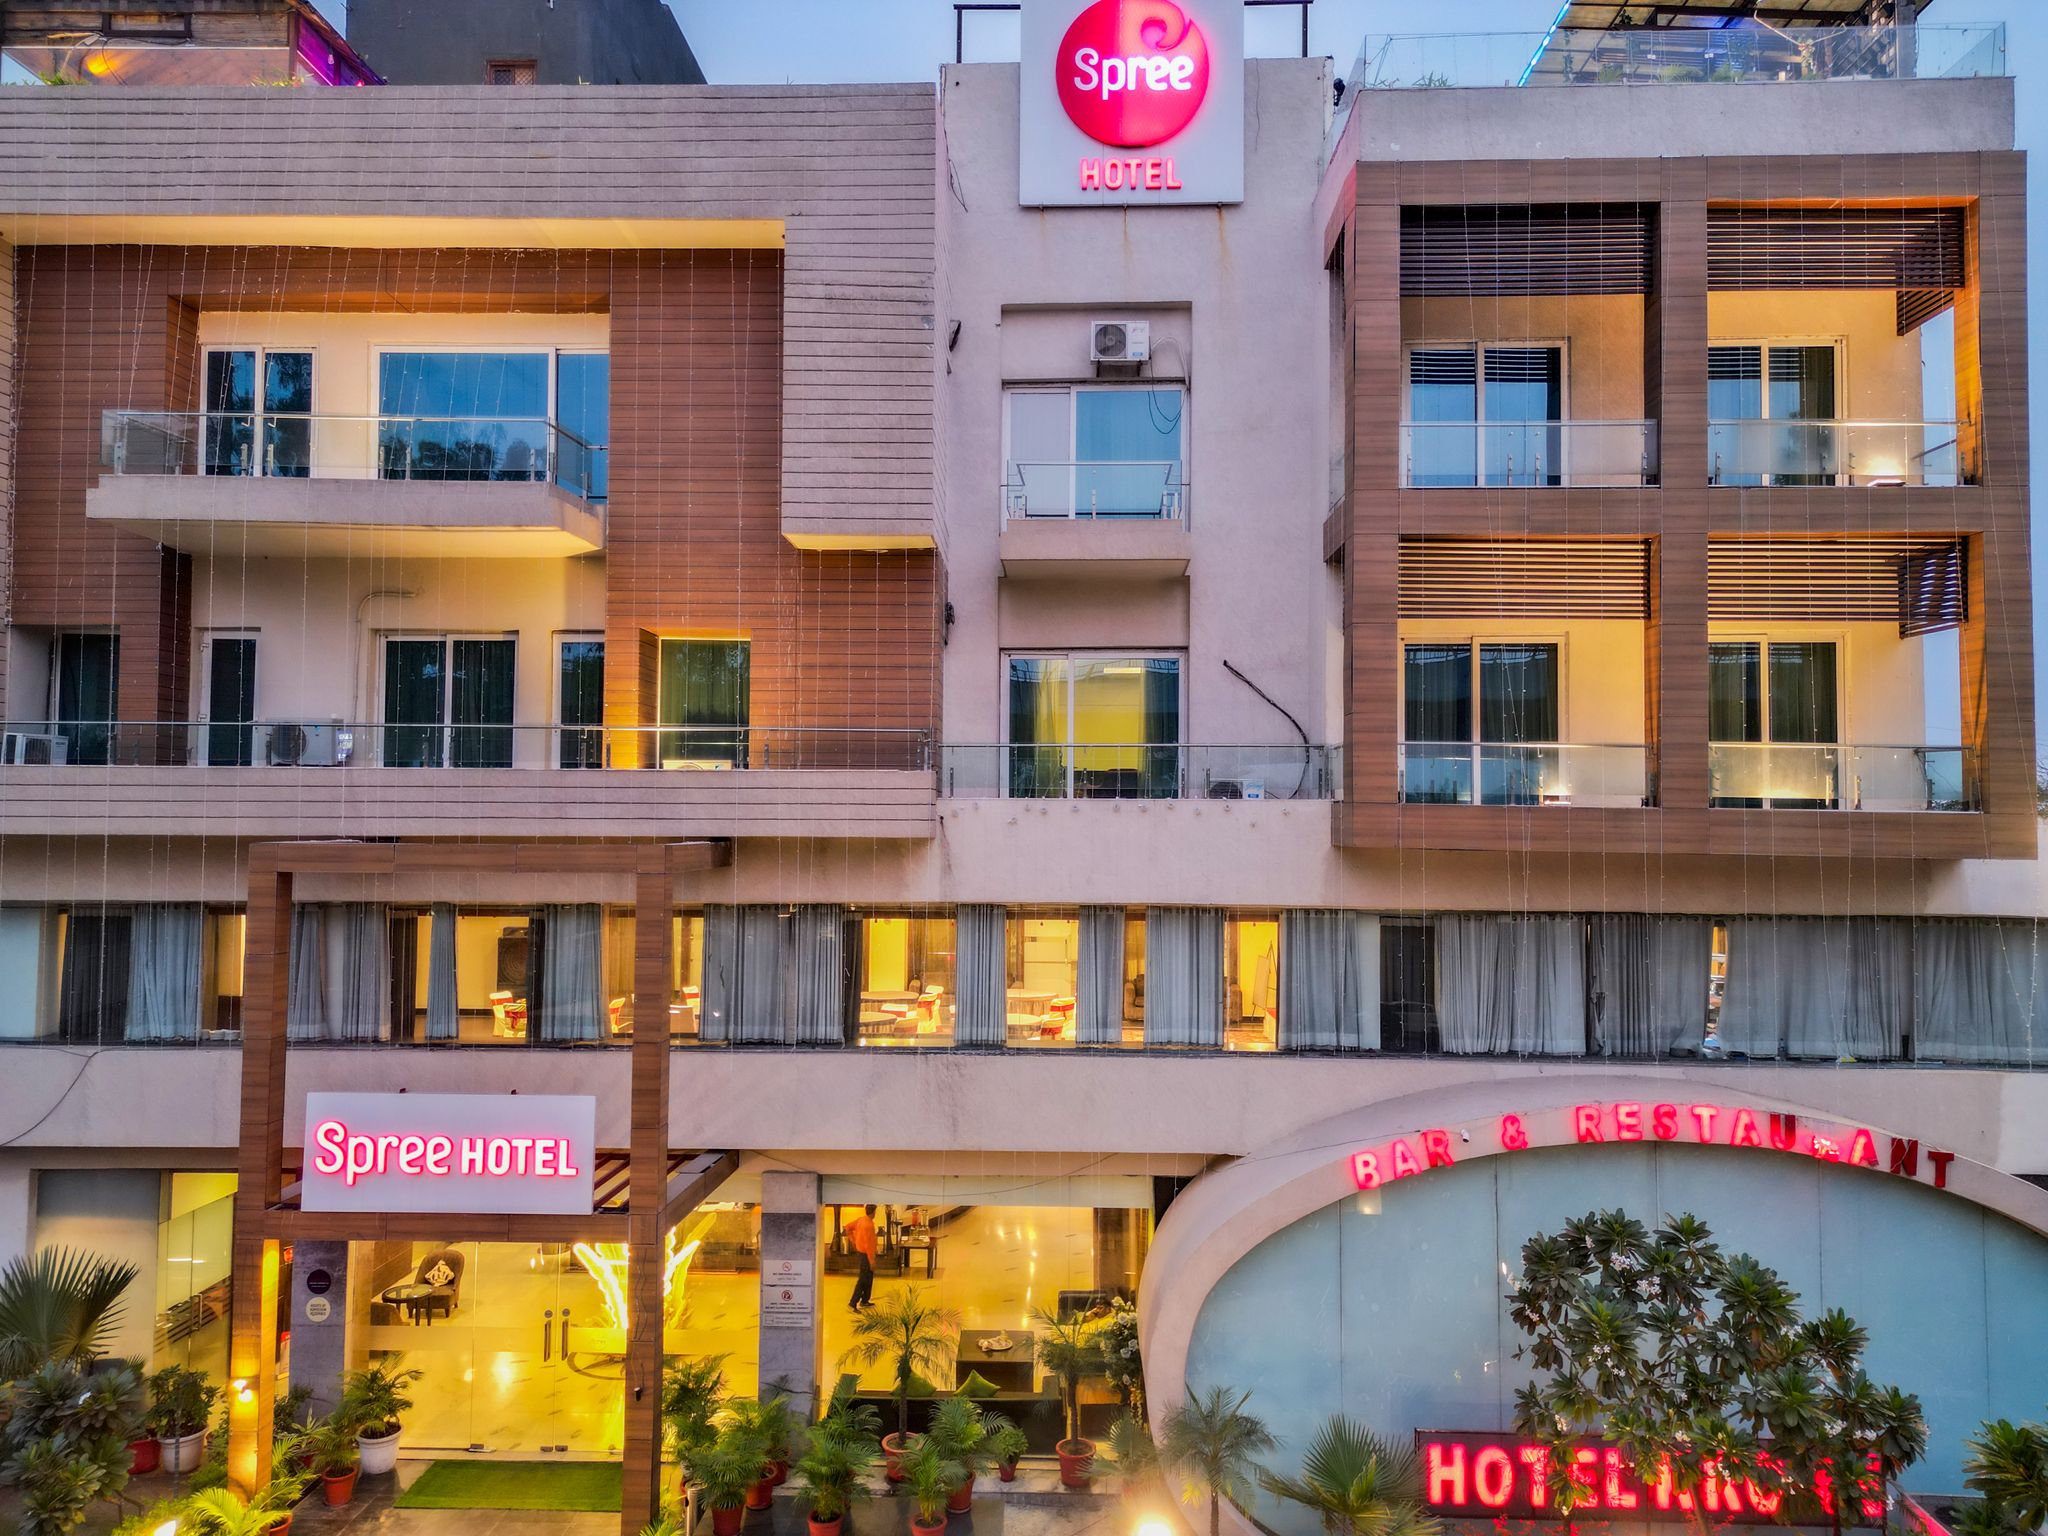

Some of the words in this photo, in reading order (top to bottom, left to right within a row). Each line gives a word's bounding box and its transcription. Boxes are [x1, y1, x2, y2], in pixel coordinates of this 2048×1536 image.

[1073, 48, 1195, 101] Spree
[1080, 157, 1182, 191] HOTEL
[314, 1121, 453, 1186] Spree
[461, 1138, 579, 1177] HOTEL
[1352, 1130, 1455, 1190] BAR
[1501, 1115, 1528, 1151] &
